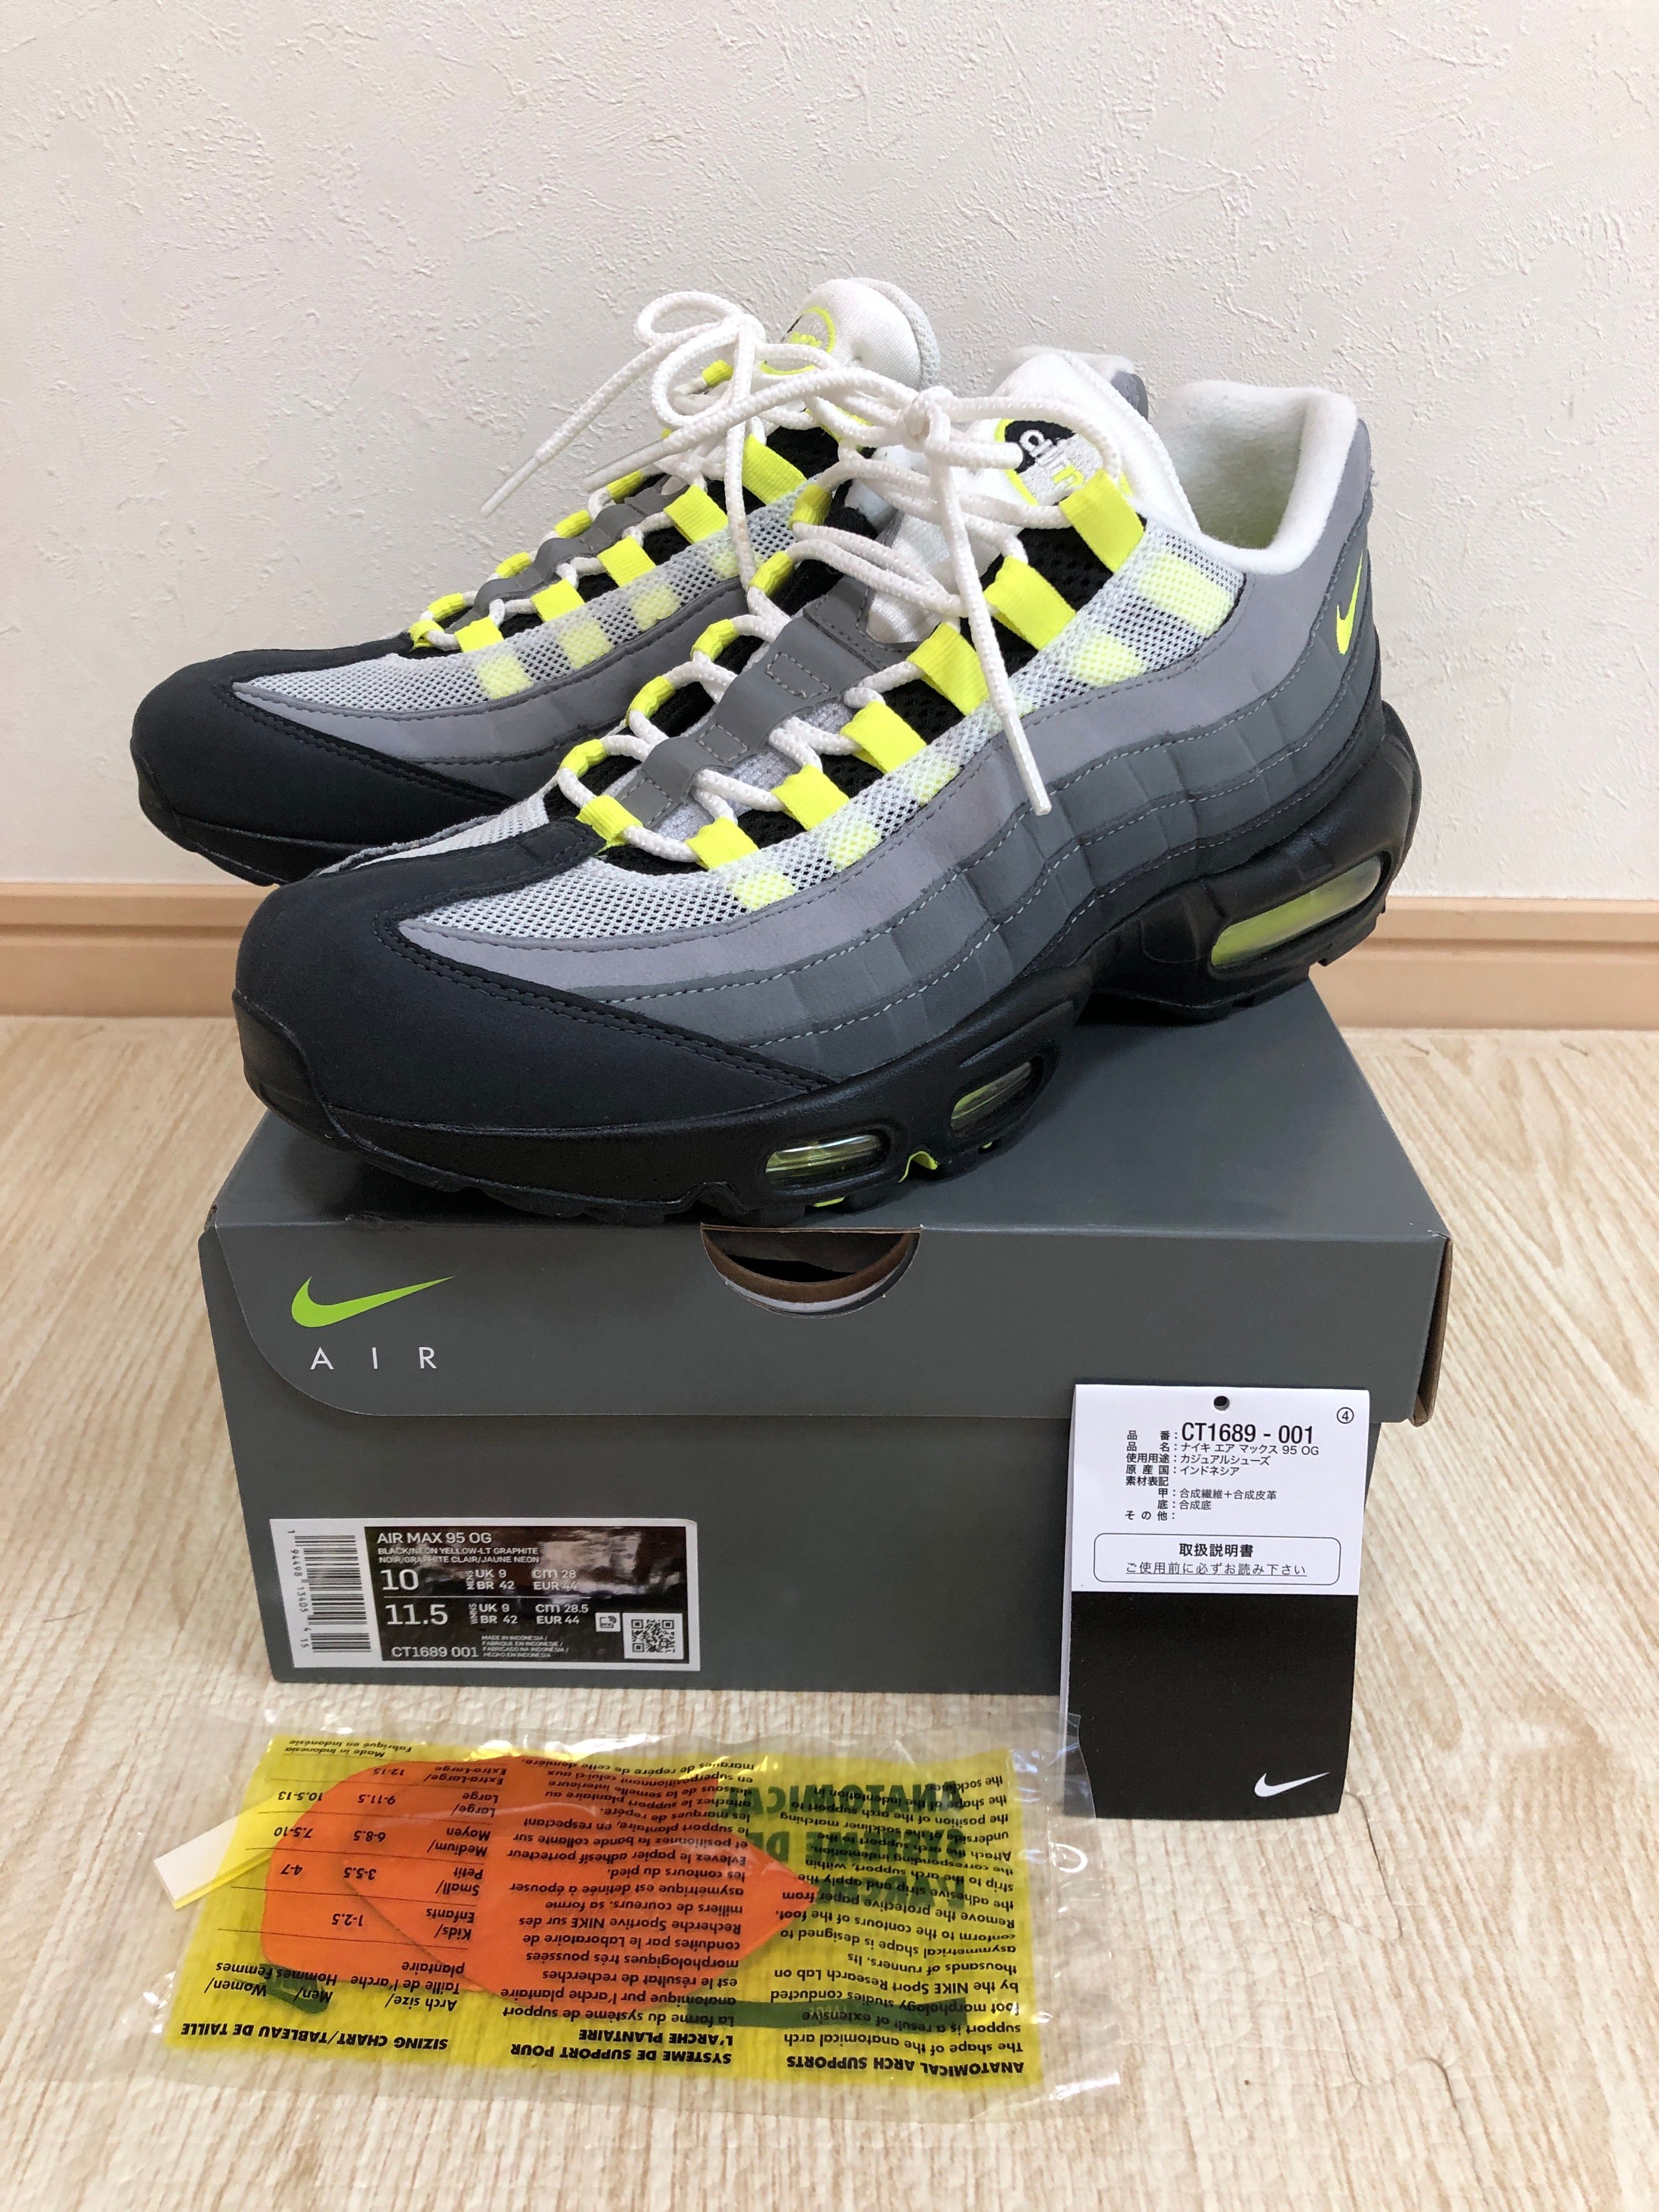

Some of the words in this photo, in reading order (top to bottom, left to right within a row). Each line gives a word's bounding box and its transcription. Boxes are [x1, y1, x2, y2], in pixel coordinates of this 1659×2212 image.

[310, 1346, 437, 1370] AIR
[1181, 1422, 1256, 1442] CT1689
[1278, 1425, 1313, 1444] 001
[1282, 1446, 1297, 1455] 95
[1301, 1446, 1319, 1456] OG
[377, 1532, 403, 1544] AIR
[407, 1532, 443, 1544] MAX
[445, 1532, 466, 1544] 95
[469, 1532, 492, 1544] OG
[1178, 1543, 1254, 1558] 取扱説明書
[475, 1569, 494, 1578] UK
[498, 1569, 506, 1578] 9
[561, 1570, 577, 1578] 28
[1125, 1561, 1306, 1576] ご使用前に必ずお読み下さい
[380, 1568, 419, 1590] 10
[466, 1570, 475, 1590] MENS
[476, 1581, 494, 1590] BR
[499, 1581, 515, 1590] 42
[533, 1581, 560, 1590] EUR
[384, 1604, 448, 1626] 11.5
[478, 1604, 498, 1612] UK
[501, 1604, 510, 1612] 9
[564, 1604, 589, 1613] 28.5
[479, 1615, 498, 1624] BR
[503, 1615, 518, 1624] 42
[536, 1615, 562, 1624] EUR
[564, 1615, 580, 1624] 44
[391, 1646, 448, 1658] CT1689
[452, 1646, 479, 1658] 001
[352, 1749, 385, 1758] Made
[373, 1767, 405, 1776] 12-15
[434, 1765, 506, 1775] Extra-Large
[424, 1773, 504, 1785] Extra-Large/
[277, 1790, 324, 1802] 10.5-13
[357, 1793, 396, 1805] 9-11.5
[462, 1791, 499, 1804] Large
[450, 1803, 496, 1818] Large/
[274, 1826, 313, 1839] 7.5-10
[353, 1830, 386, 1842] 6-8.5
[446, 1826, 490, 1841] Moyen
[427, 1839, 488, 1857] Medium/
[280, 1864, 303, 1875] 4-7
[343, 1866, 376, 1880] 3-5.5
[453, 1866, 483, 1880] Petit
[435, 1880, 480, 1897] Small/
[331, 1914, 363, 1926] 1-2.5
[426, 1908, 475, 1923] Enfants
[434, 1925, 472, 1940] Kids/
[526, 1951, 589, 1965] poussées
[624, 1953, 739, 1970] morphologiques
[215, 1962, 273, 1980] Femmes
[402, 1961, 465, 1976] plantaire
[774, 1969, 792, 1978] on
[797, 1969, 821, 1980] Lab
[276, 1968, 338, 1985] Hommes
[543, 1971, 617, 1985] recherches
[621, 1974, 639, 1987] de
[643, 1974, 697, 1988] résultat
[701, 1977, 713, 1990] le
[718, 1978, 737, 1988] est
[827, 1969, 888, 1991] Research
[204, 1977, 267, 1997] Women/
[403, 1979, 420, 1993] de
[425, 1980, 460, 1995] Taille
[892, 1980, 929, 1994] Sport
[934, 1982, 968, 1994] NIKE
[973, 1982, 995, 1995] the
[1000, 1979, 1018, 1993] by
[292, 1988, 333, 2003] Men/
[384, 1994, 420, 2009] size/
[500, 1988, 565, 2002] plantaire
[621, 1990, 646, 2004] pur
[651, 1991, 736, 2007] anatomique
[425, 1998, 458, 2012] Arch
[503, 2005, 558, 2020] support
[562, 2009, 580, 2022] de
[585, 2009, 644, 2024] système
[648, 2013, 666, 2025] du
[672, 2013, 714, 2027] forme
[718, 2016, 734, 2027] La
[181, 2023, 228, 2035] TAILLE
[233, 2023, 254, 2036] DE
[258, 2025, 388, 2047] CHART/TABLEAU
[578, 2029, 663, 2043] PLANTAIRE
[393, 2036, 448, 2050] SIZING
[784, 2033, 815, 2045] arch
[820, 2033, 899, 2046] anatomical
[510, 2044, 555, 2057] POUR
[560, 2046, 631, 2060] SUPPORT
[904, 2040, 926, 2055] the
[930, 2045, 944, 2056] of
[949, 2041, 992, 2055] shape
[998, 2041, 1023, 2052] The
[637, 2050, 657, 2061] DE
[663, 2050, 731, 2064] SYSTEME
[786, 2056, 867, 2069] SUPPORTS
[873, 2057, 915, 2071] ARCH
[921, 2062, 1024, 2077] ANATOMICAL
